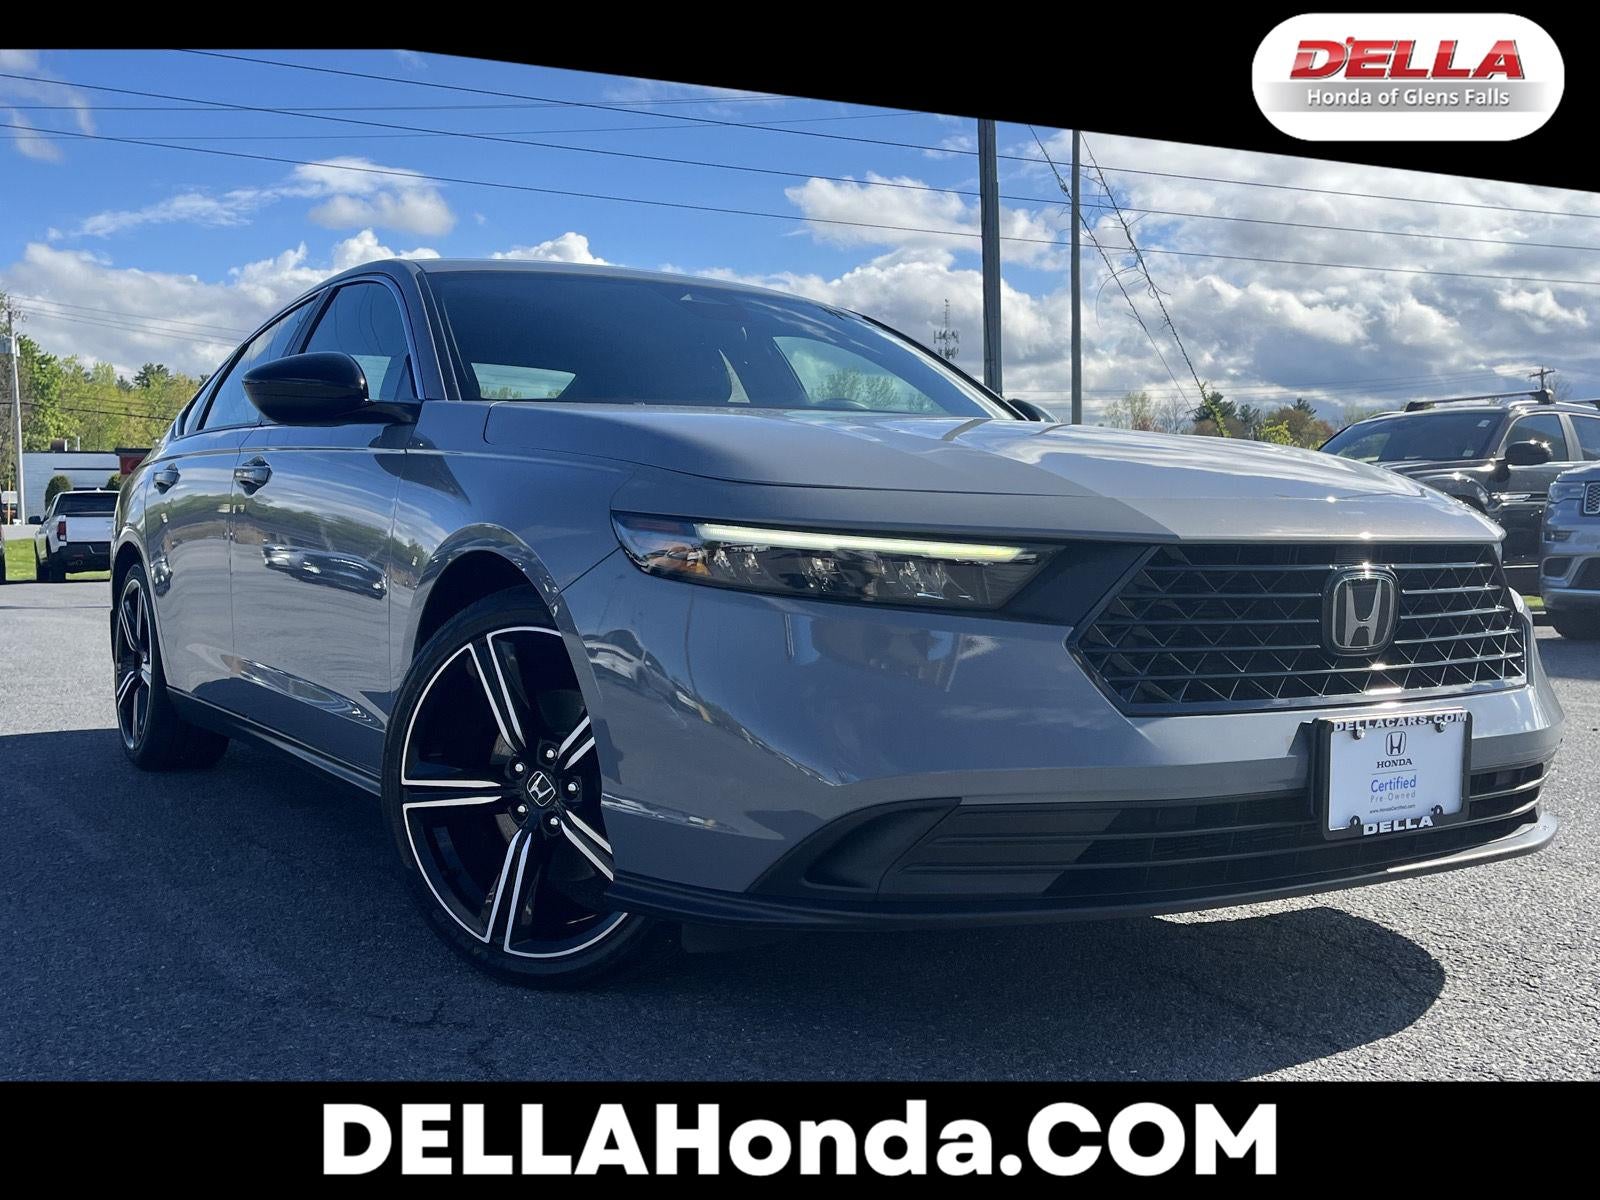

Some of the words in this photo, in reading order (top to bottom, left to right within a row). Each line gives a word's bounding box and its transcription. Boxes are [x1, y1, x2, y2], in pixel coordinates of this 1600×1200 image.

[1333, 712, 1467, 731] DELLACARS.COM
[1376, 758, 1413, 769] HONDA
[1370, 775, 1417, 793] Certified
[1387, 790, 1416, 801] Owned
[1363, 815, 1434, 836] DELLA
